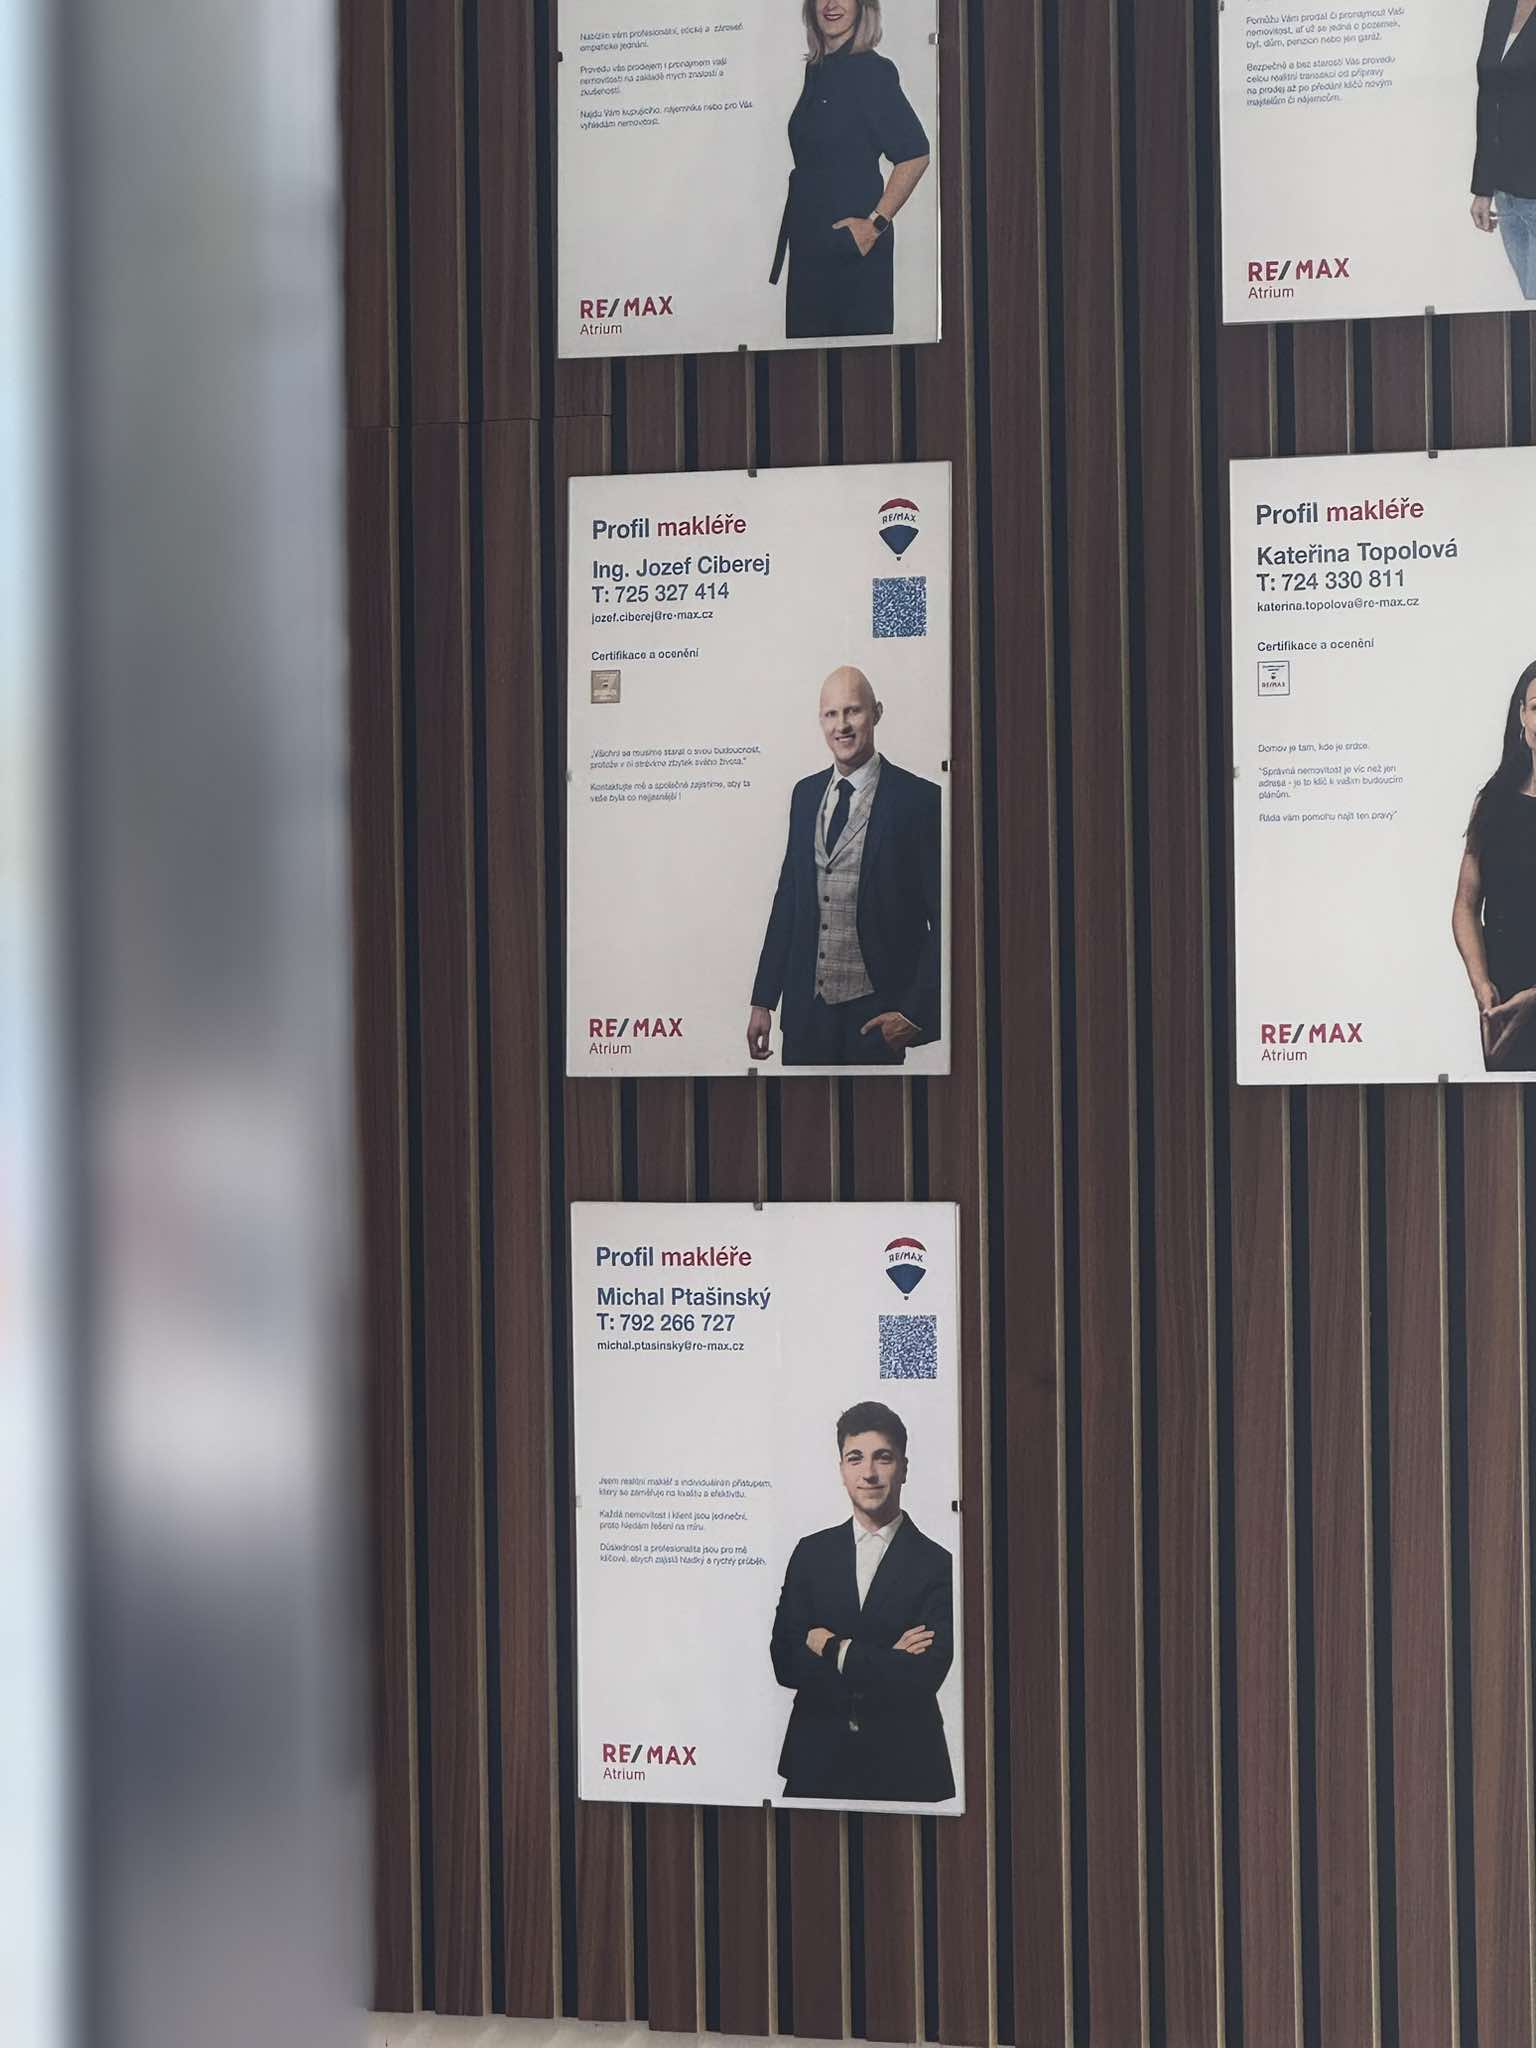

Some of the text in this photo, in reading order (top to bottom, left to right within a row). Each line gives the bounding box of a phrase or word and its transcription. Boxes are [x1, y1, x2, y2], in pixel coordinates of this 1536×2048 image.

[1248, 258, 1349, 282] RE/MAX
[1248, 286, 1294, 299] Atrium
[580, 296, 673, 319] RE/MAX
[580, 323, 622, 335] Atrium
[882, 512, 916, 524] RE/MAX
[1256, 497, 1424, 525] Profil makléře
[592, 513, 747, 540] Profil makléře
[1257, 538, 1458, 566] Kateřina Topolová
[592, 553, 770, 583] Ing. Jozef Ciberej
[1256, 569, 1404, 592] T: 724 330 811
[592, 582, 730, 604] T: 725 327 414
[1257, 597, 1419, 612] katerina.topolova@re-max.cz
[591, 610, 714, 625] jozef.ciberej@re-max.cz
[1257, 639, 1317, 652] Certifikace
[1330, 637, 1375, 649] ocenění
[591, 648, 699, 661] Certifikace a ocenění
[589, 1018, 683, 1038] RE/MAX
[1261, 1023, 1363, 1044] RE/MAX
[589, 1042, 632, 1055] Atrium
[1261, 1048, 1307, 1061] Atrium
[596, 1246, 752, 1267] Profil makléře
[889, 1252, 923, 1263] RE/MAX
[597, 1287, 771, 1310] Michal Ptašinský
[596, 1313, 735, 1331] T: 792 266 727
[597, 1340, 744, 1352] michal.ptasinsky@re-max.cz
[603, 1743, 696, 1766] RE/MAX
[603, 1767, 645, 1780] Atrium
